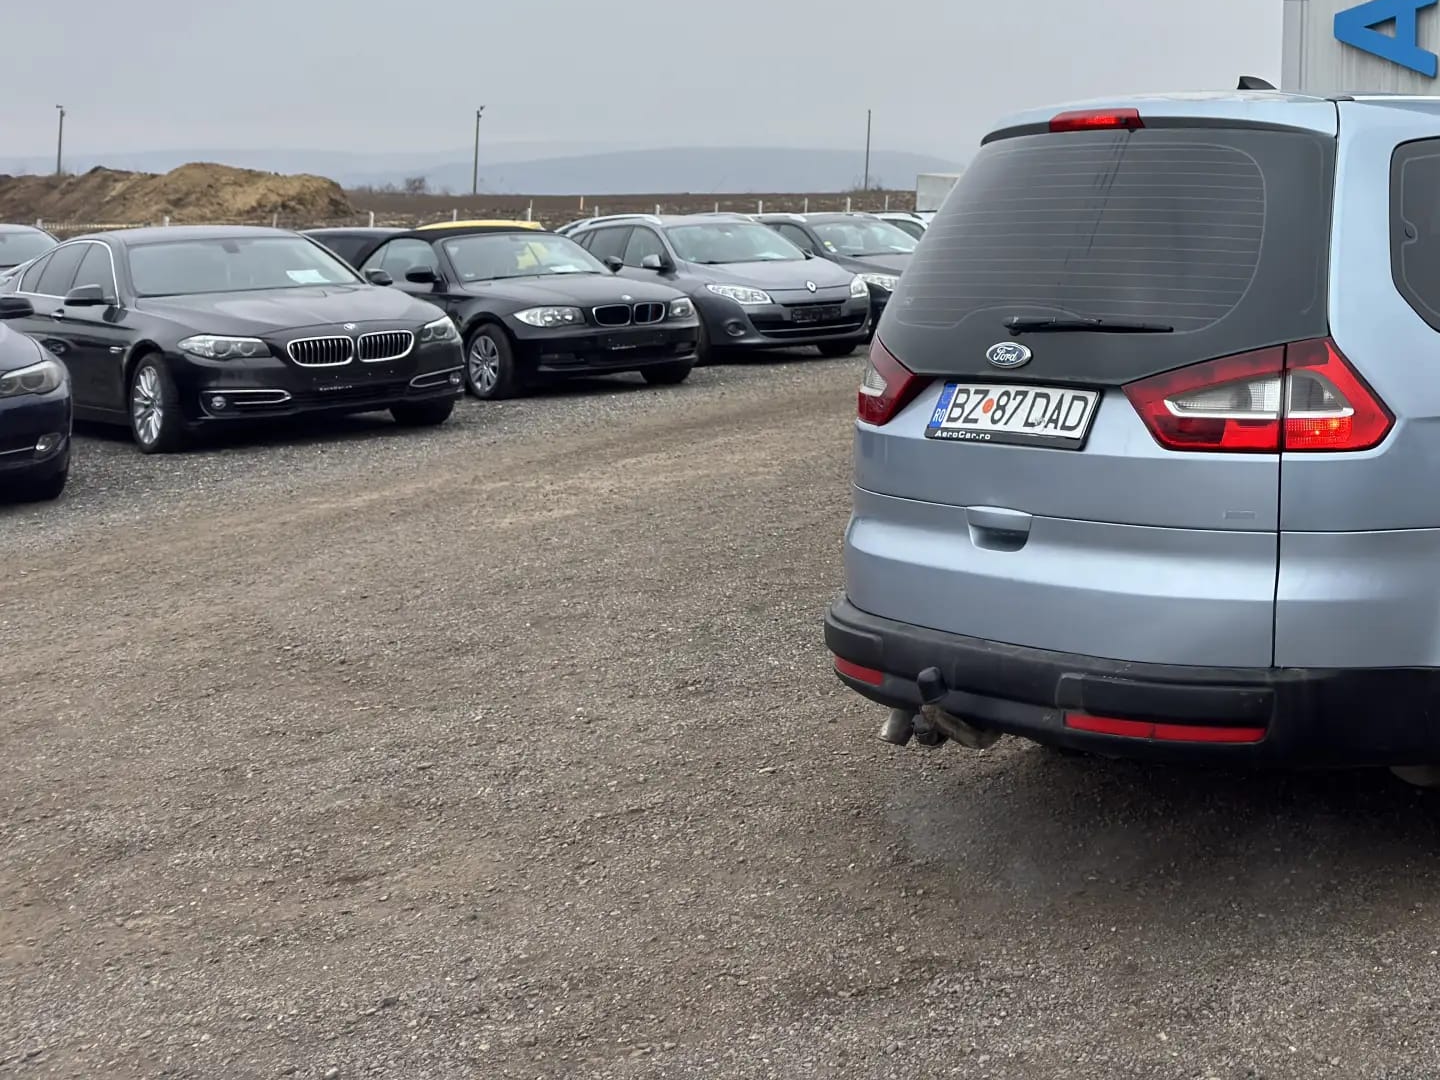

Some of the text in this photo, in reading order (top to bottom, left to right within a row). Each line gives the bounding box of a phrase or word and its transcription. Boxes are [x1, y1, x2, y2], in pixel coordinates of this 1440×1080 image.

[993, 346, 1018, 362] Ford
[933, 408, 946, 422] RO
[945, 388, 1089, 432] BZ 87 DAD
[934, 430, 991, 440] AeroCar.ro
